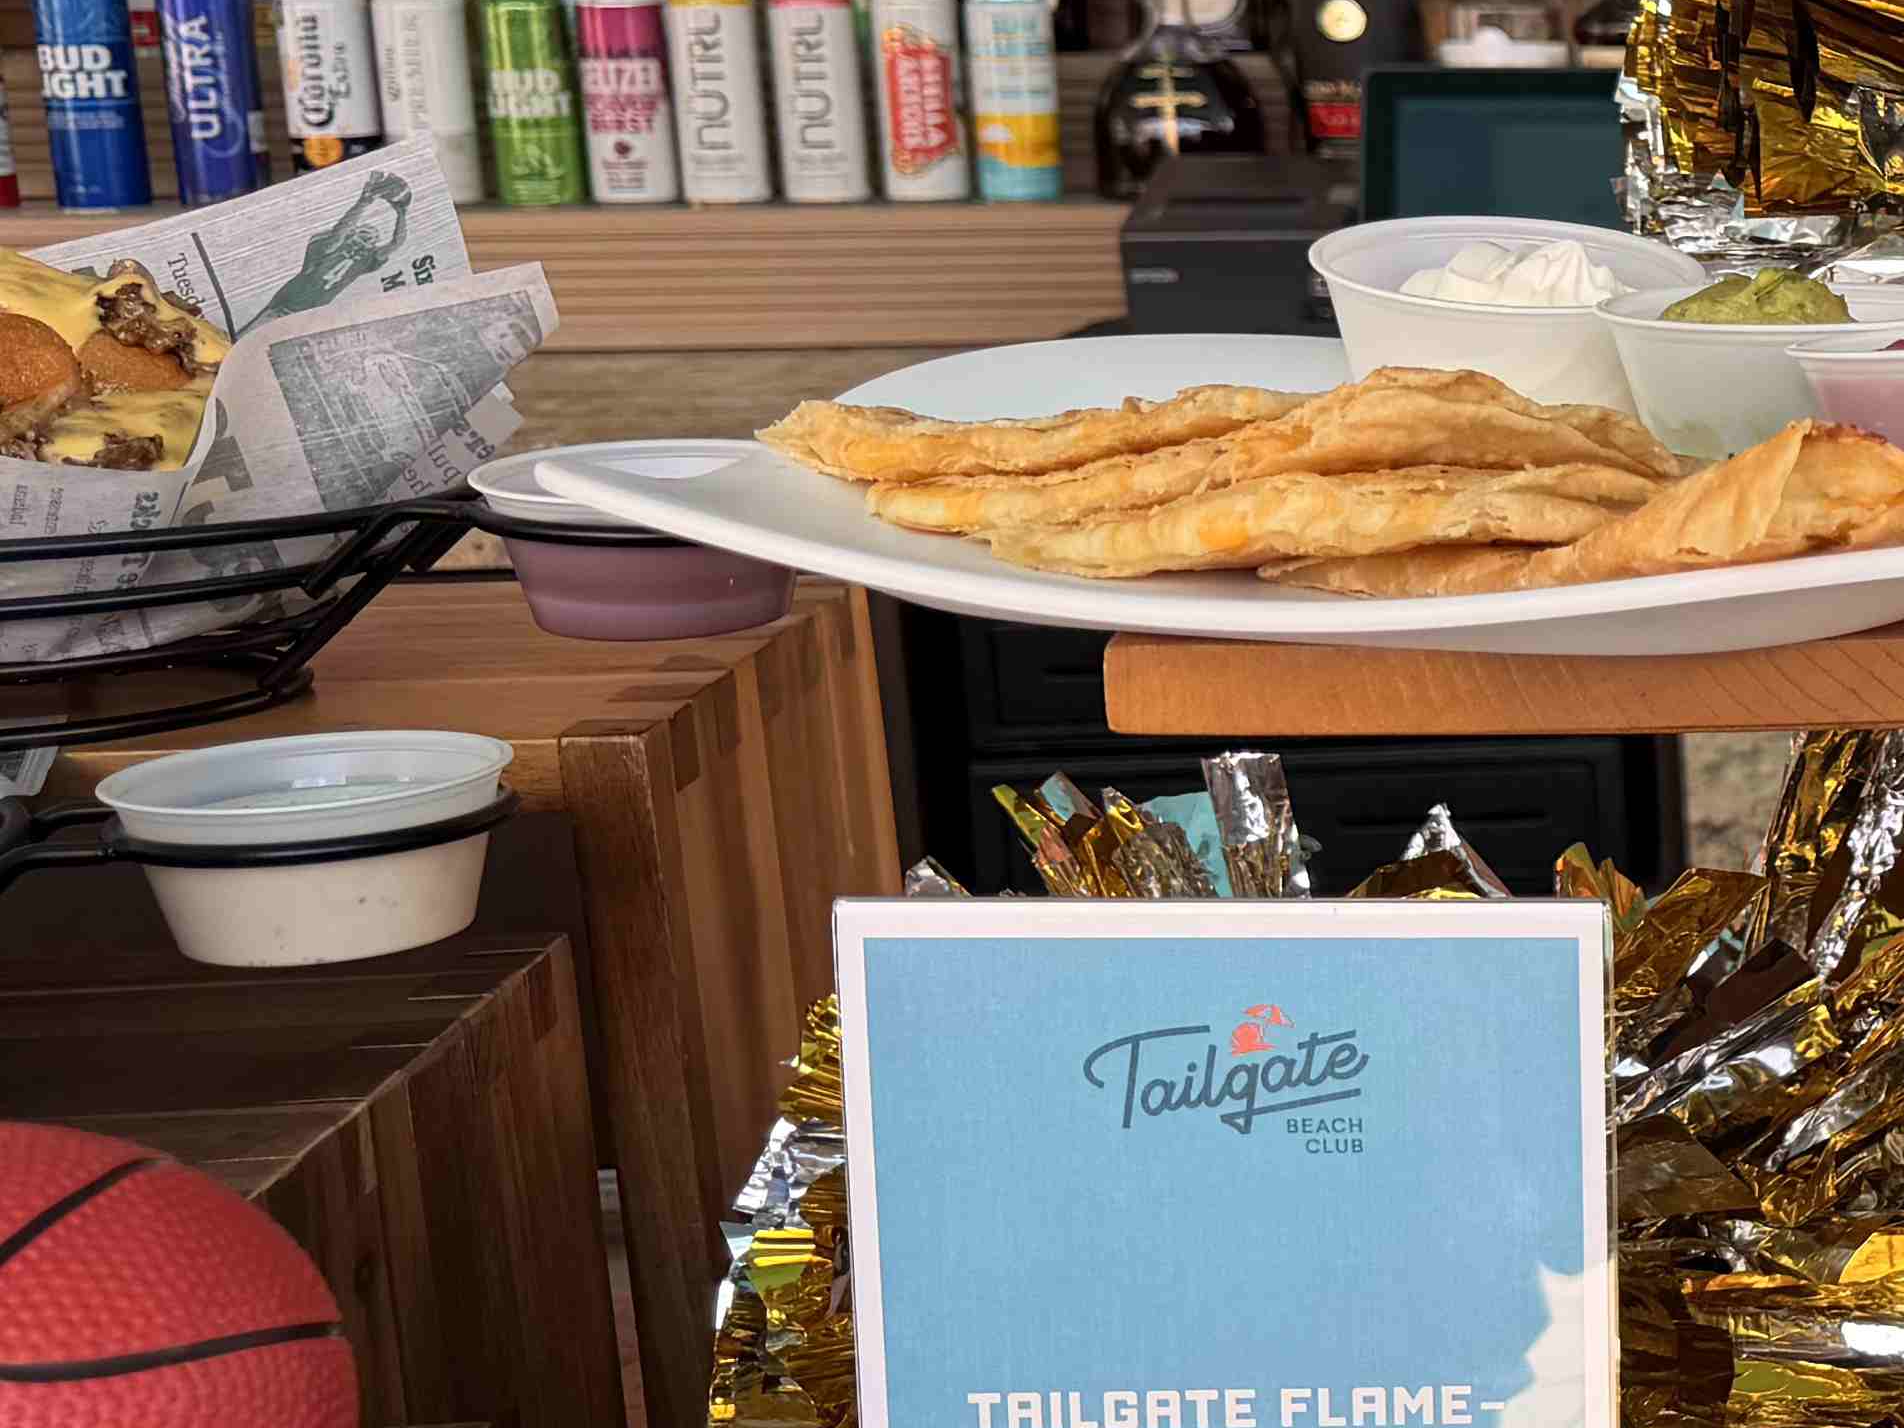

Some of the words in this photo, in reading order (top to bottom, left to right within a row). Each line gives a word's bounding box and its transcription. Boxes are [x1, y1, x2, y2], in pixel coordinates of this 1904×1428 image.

[37, 44, 112, 72] BUD
[189, 16, 222, 140] ULTRA
[299, 14, 335, 128] Corona
[1083, 1023, 1369, 1135] Tailgate
[1287, 1117, 1364, 1135] BEACH
[1305, 1137, 1365, 1155] CLUB
[1280, 1384, 1505, 1428] FLAME-
